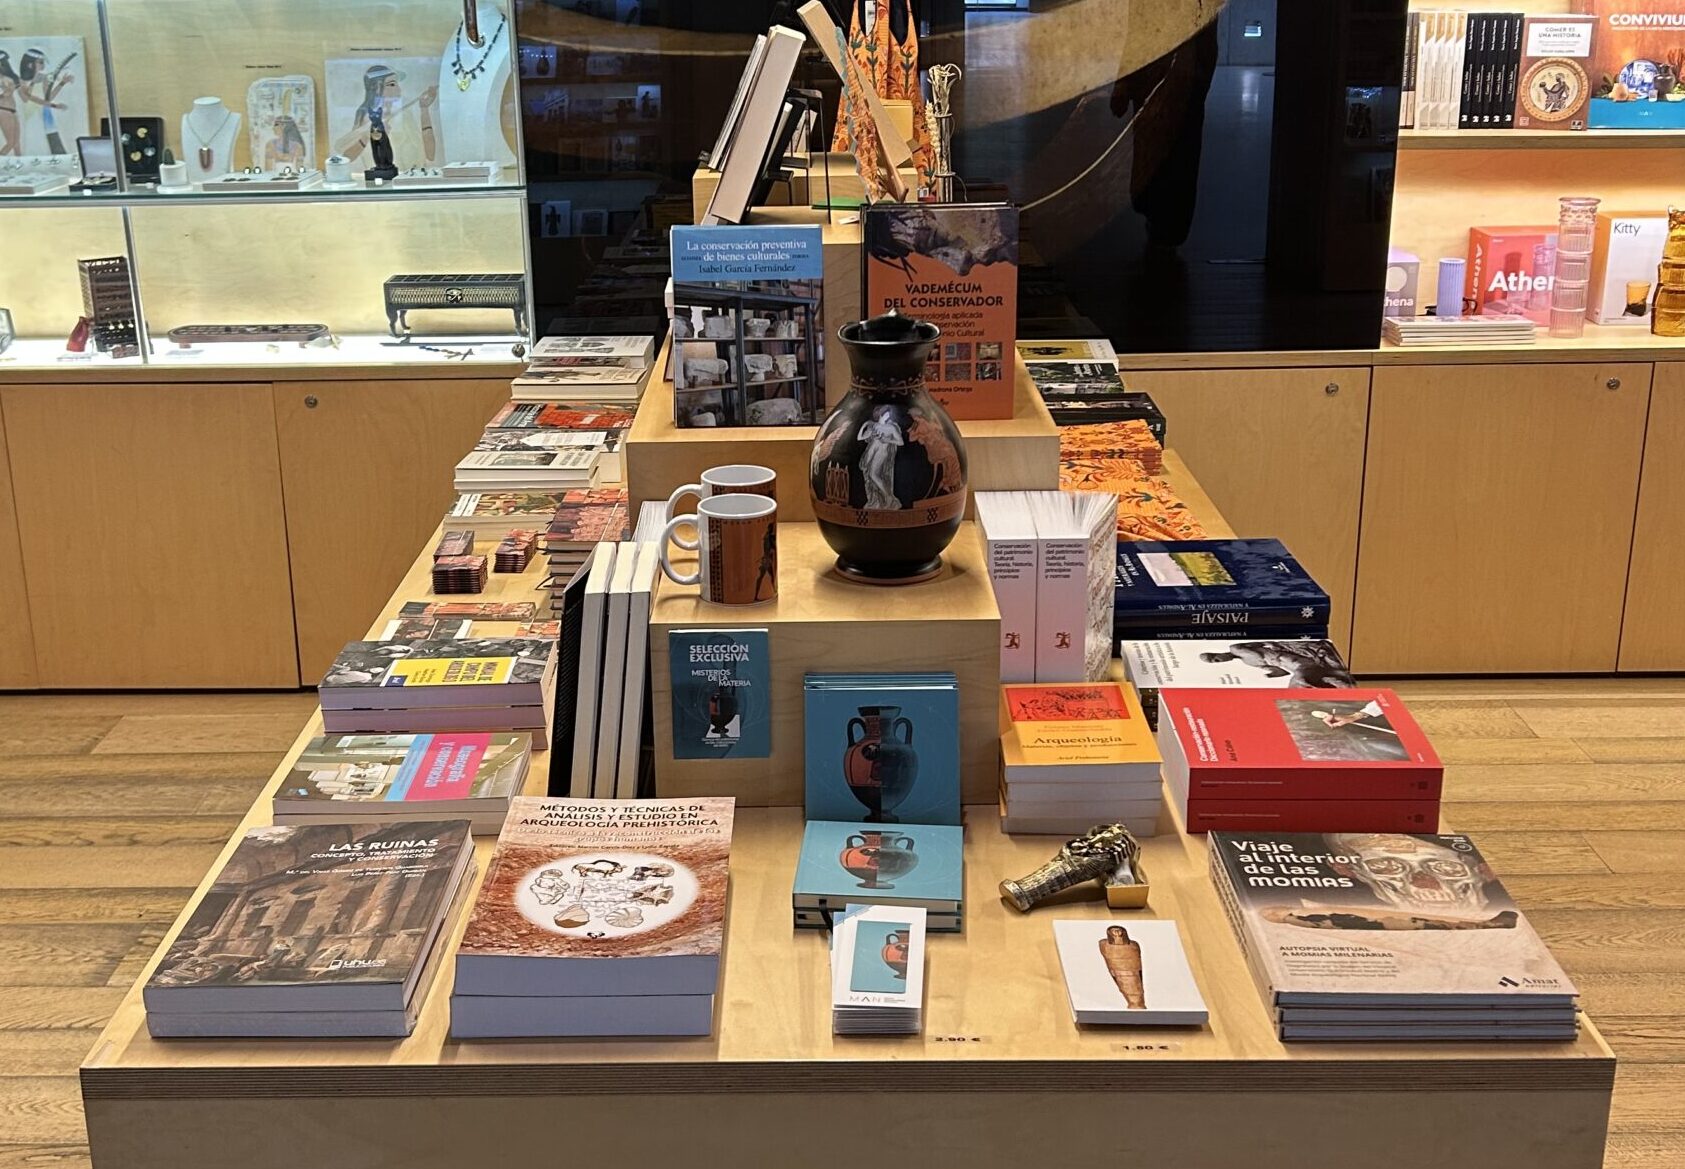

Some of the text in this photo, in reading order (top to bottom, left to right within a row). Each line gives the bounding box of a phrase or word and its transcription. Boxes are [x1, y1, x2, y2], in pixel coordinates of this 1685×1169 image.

[1608, 13, 1685, 26] CONVIVIU
[1613, 222, 1642, 237] Kitty
[687, 239, 807, 251] La conservación preventiva
[703, 252, 714, 261] de
[716, 251, 745, 261] bienes
[747, 251, 790, 260] culturales
[699, 263, 796, 273] Isabel García Fernández
[904, 281, 983, 294] VADEMÉCUM
[884, 295, 1004, 309] DEL CONSERVADOR
[1384, 296, 1414, 307] hena
[951, 311, 984, 320] aplicada
[956, 329, 985, 337] Cultural
[1191, 610, 1249, 624] PAISAJE
[689, 642, 749, 653] SELECCIÓN
[689, 653, 750, 662] EXCLUSIVA
[691, 668, 731, 676] MISTERIOS
[1034, 734, 1123, 746] Arqueología
[540, 803, 606, 813] MÉTODOS
[624, 805, 685, 813] TÉCNICAS
[689, 804, 706, 812] DE
[544, 811, 603, 820] ANÁLISIS
[619, 813, 676, 821] ESTUDIO
[520, 818, 718, 828] ARQUEOLOGÍA PREHISTÓRICA
[329, 839, 439, 851] LAS RUINAS
[1231, 841, 1294, 854] Viaje
[356, 852, 434, 862] CONSERVACIÓN
[369, 848, 436, 856] TRATAMIENTO
[1239, 852, 1362, 864] al interior
[1243, 863, 1320, 875] de las
[849, 995, 881, 1003] MAN
